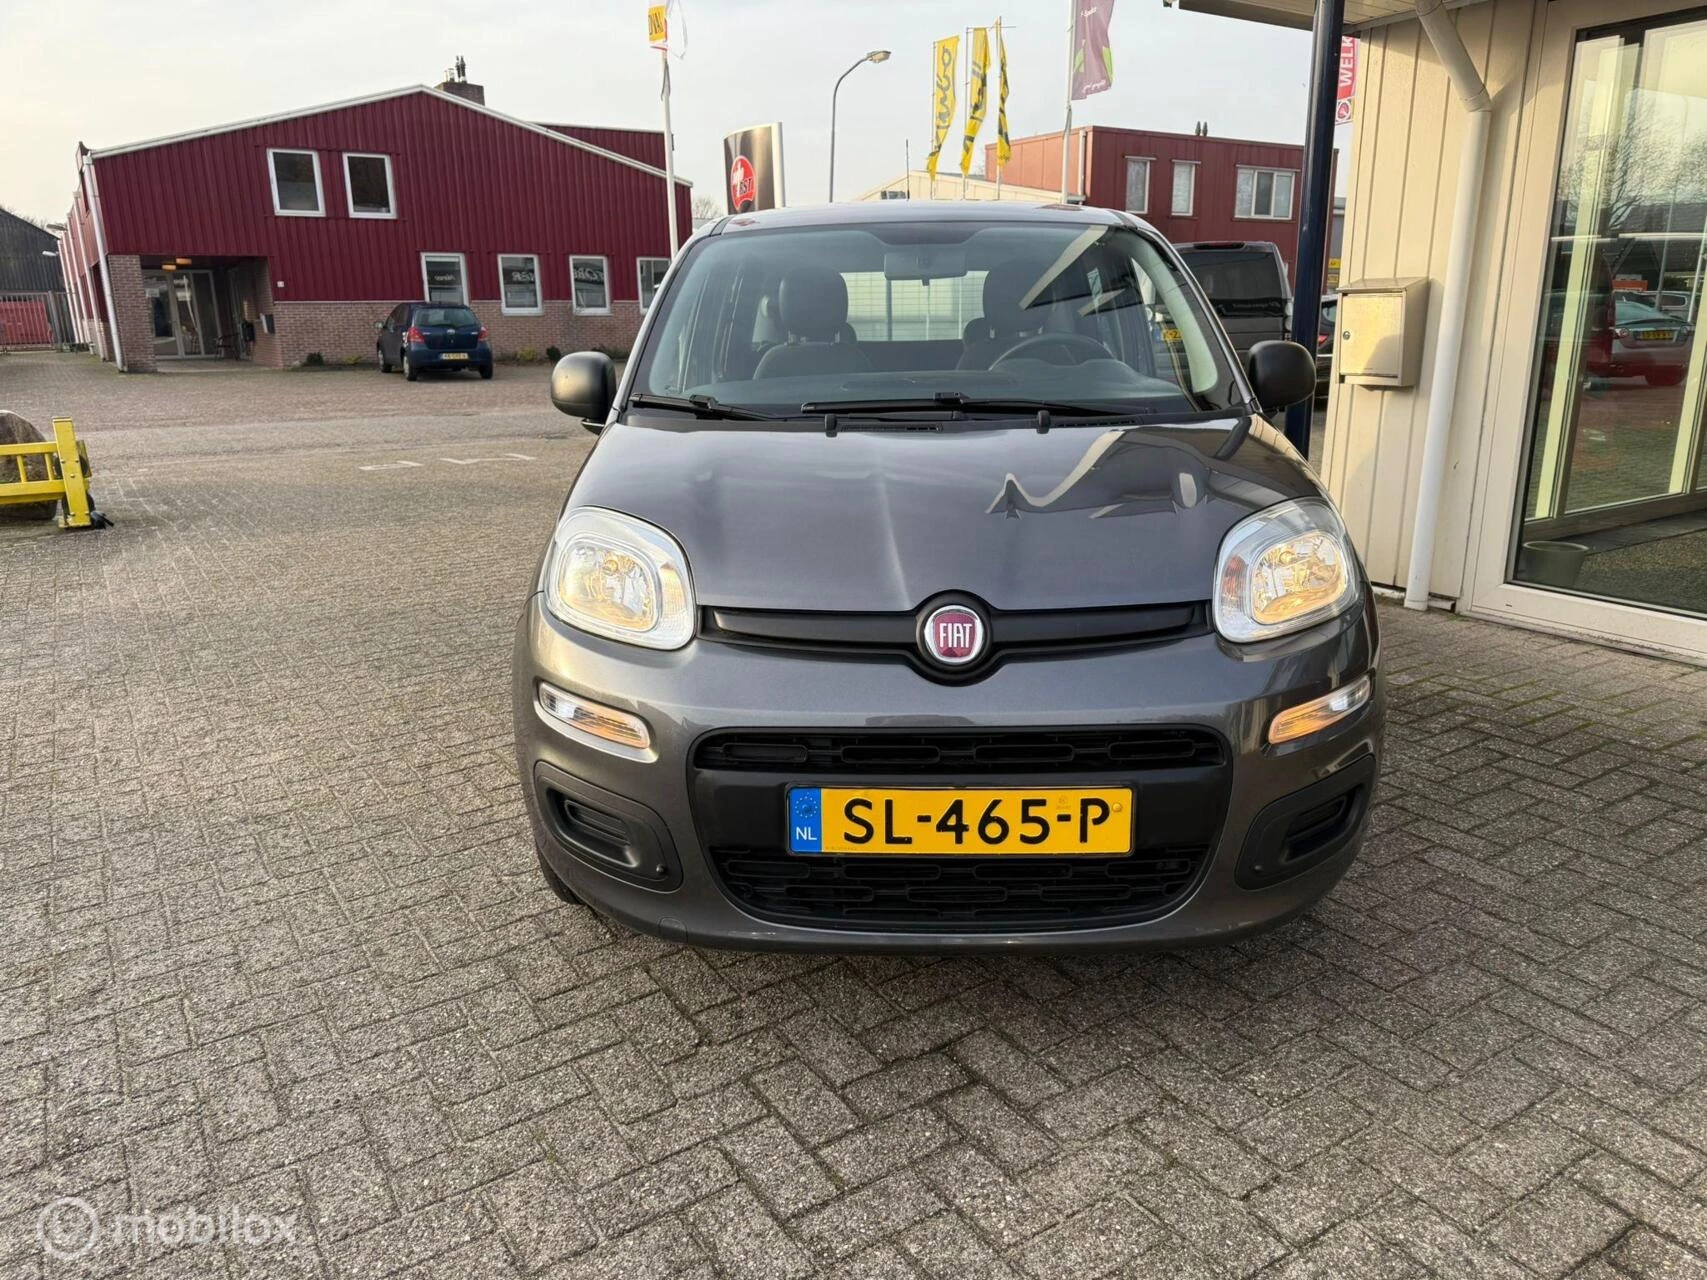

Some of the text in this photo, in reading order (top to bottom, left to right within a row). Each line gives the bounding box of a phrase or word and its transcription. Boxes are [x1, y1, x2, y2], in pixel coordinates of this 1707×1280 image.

[939, 623, 973, 648] FIAT
[795, 826, 818, 841] NL
[843, 798, 1111, 845] SL-465-P
